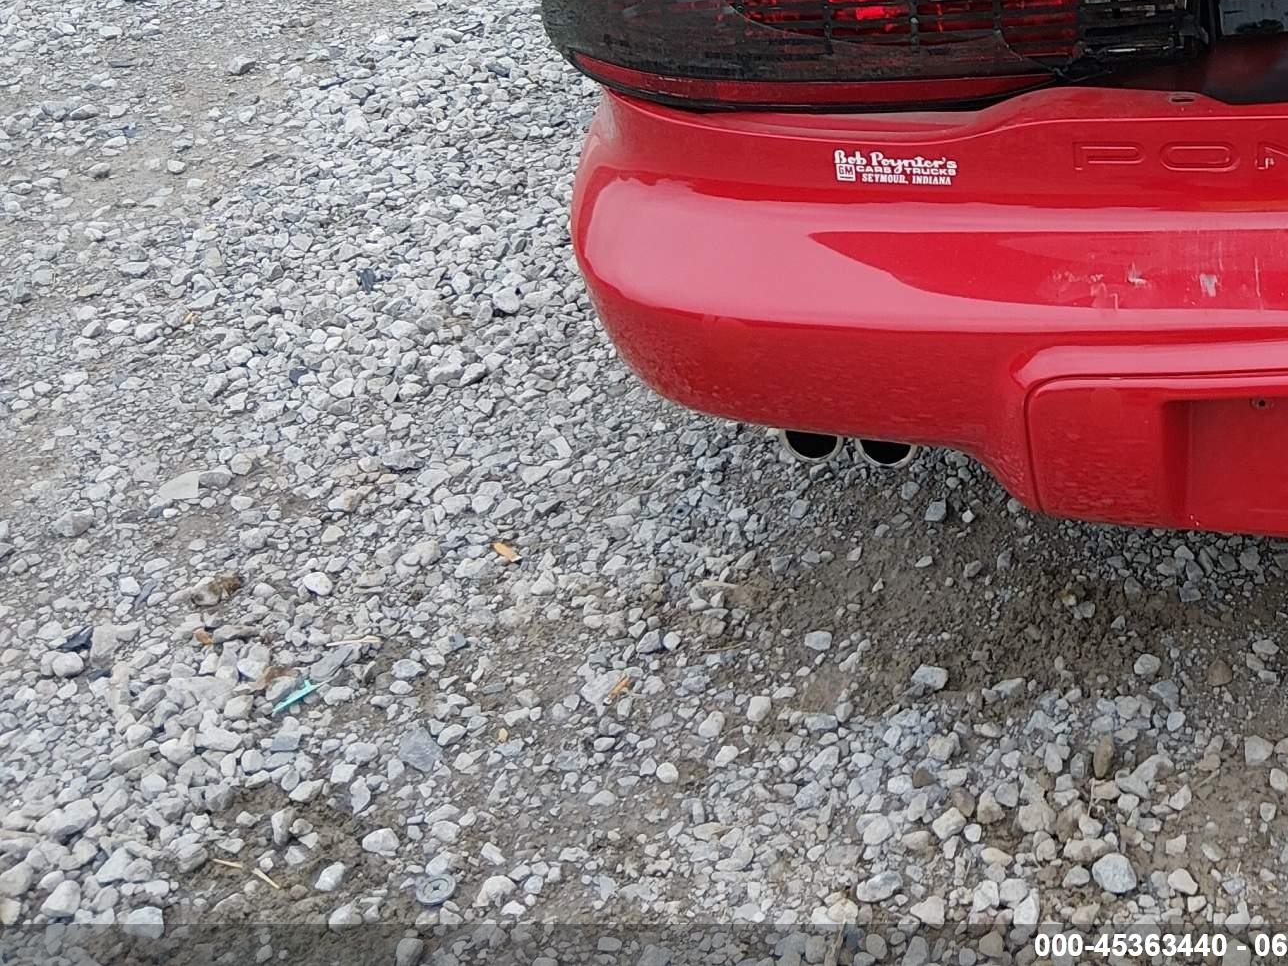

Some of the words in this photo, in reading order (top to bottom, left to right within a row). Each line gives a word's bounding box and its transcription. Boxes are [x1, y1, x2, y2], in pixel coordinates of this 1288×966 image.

[834, 149, 867, 165] Bob
[870, 151, 957, 174] Poynter's
[903, 167, 956, 176] TRUCKS
[862, 173, 909, 185] SEYMOUR,
[912, 175, 952, 186] INDIANA
